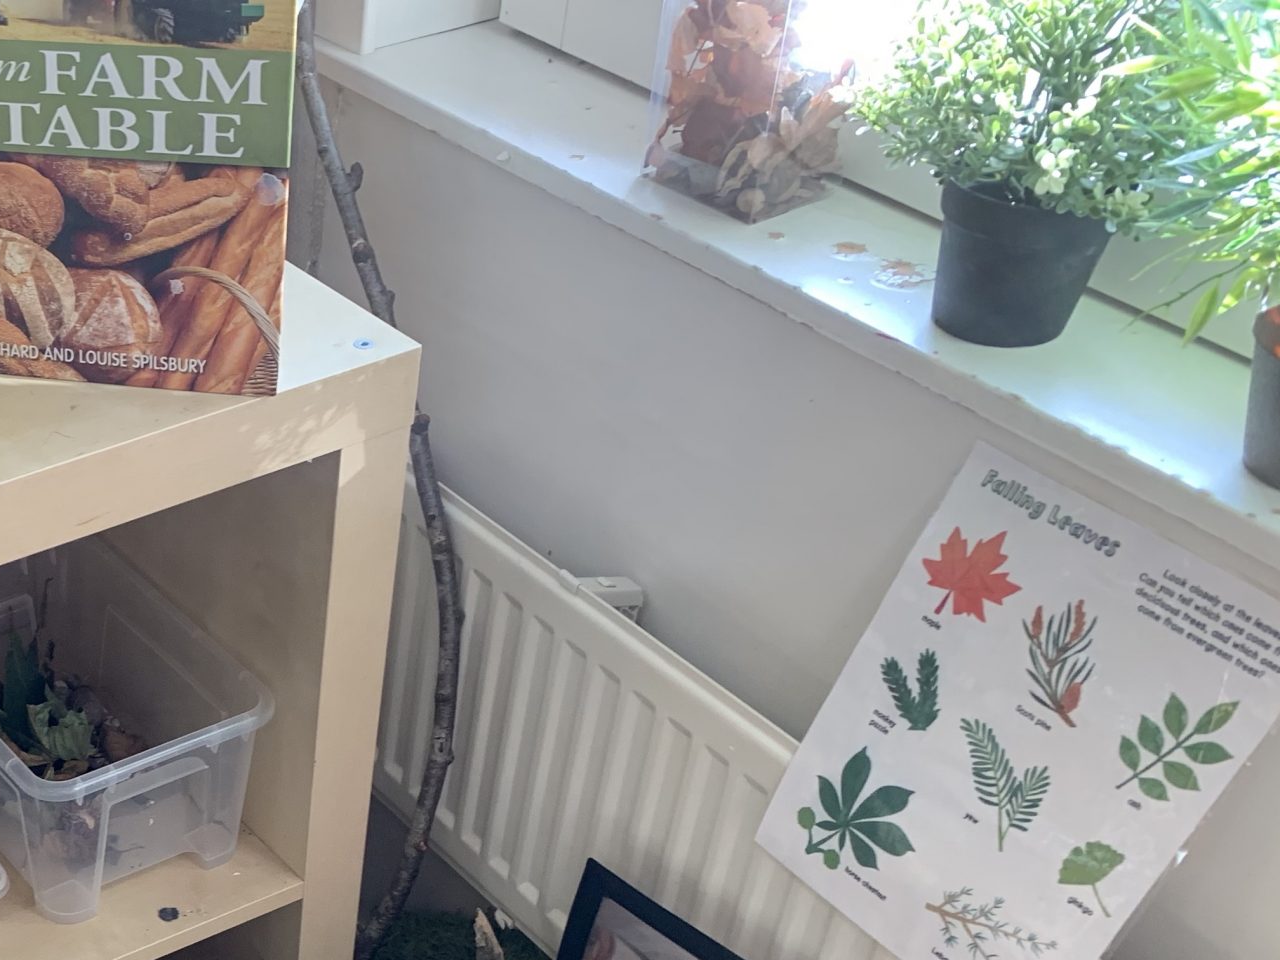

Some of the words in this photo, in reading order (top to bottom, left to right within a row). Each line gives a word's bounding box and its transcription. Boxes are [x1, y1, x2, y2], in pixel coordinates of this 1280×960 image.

[38, 49, 271, 106] FARM
[44, 347, 74, 363] AND
[79, 349, 128, 367] LOUISE
[132, 353, 207, 374] SPILSBURY
[981, 469, 1046, 520] Falling
[1047, 504, 1121, 557] Leaves
